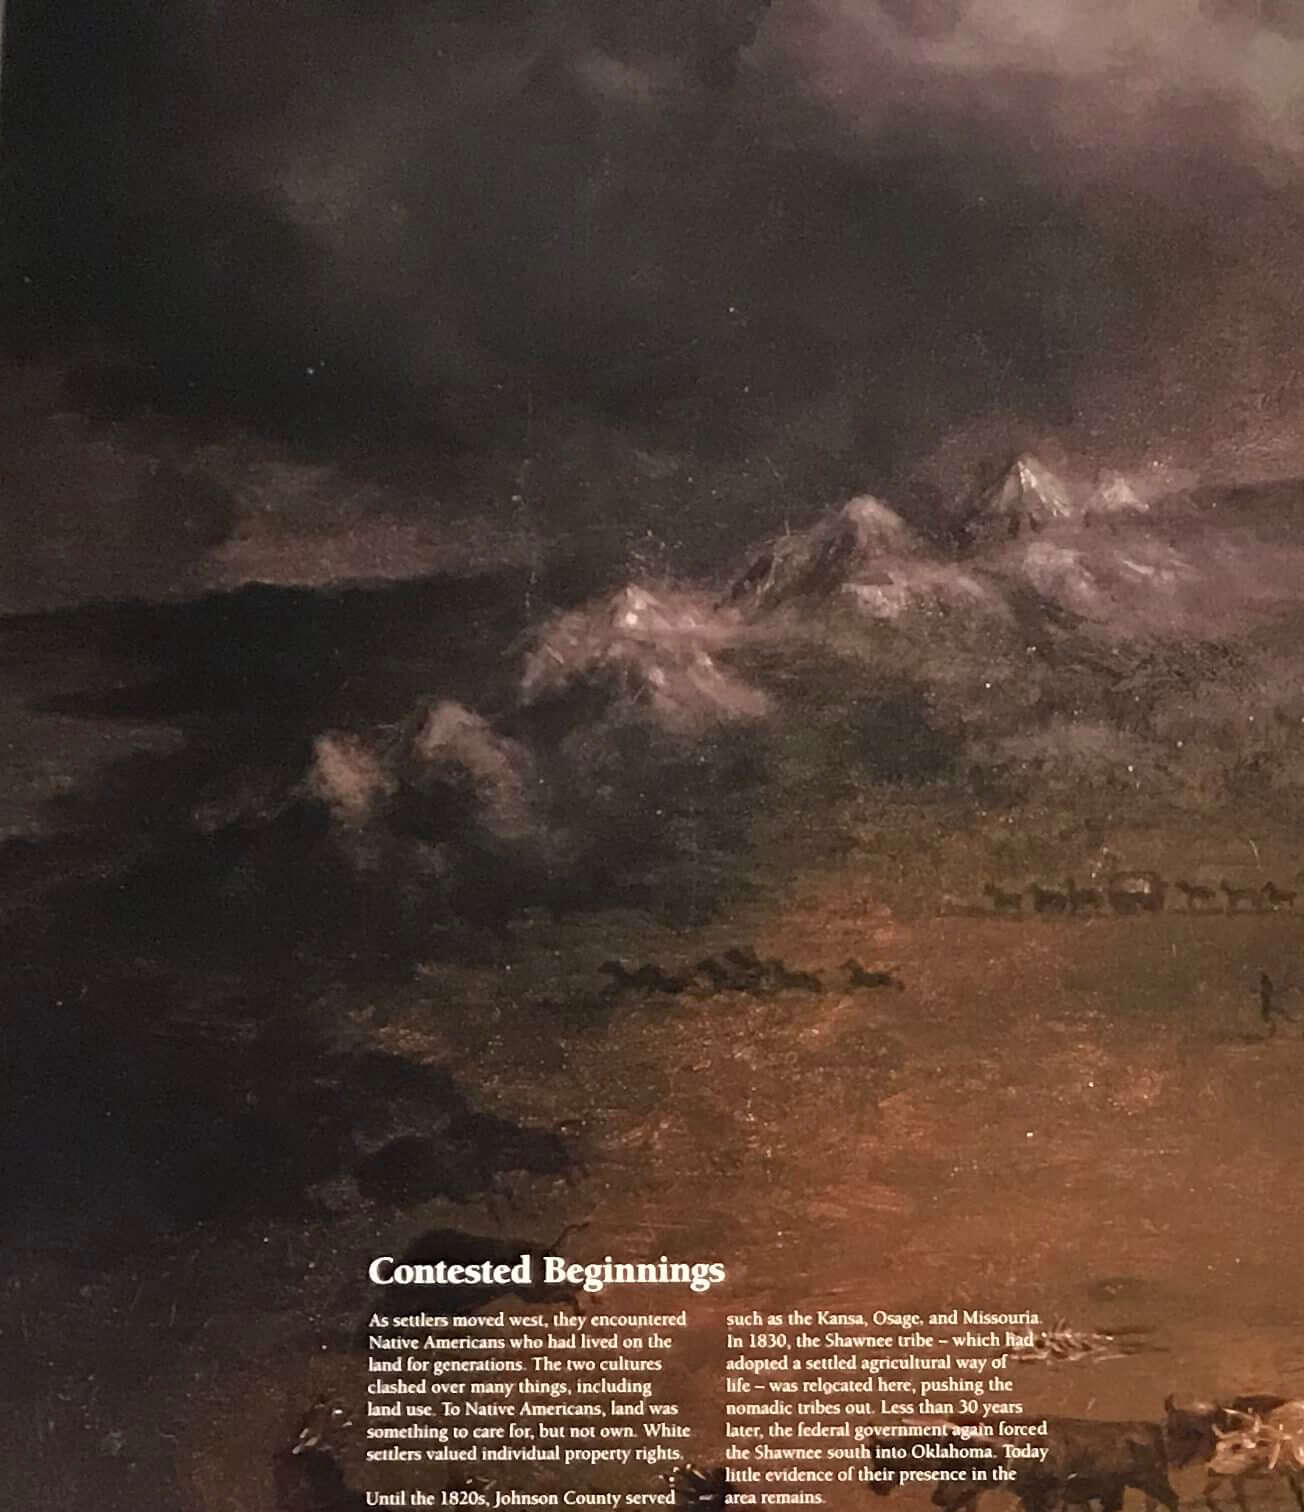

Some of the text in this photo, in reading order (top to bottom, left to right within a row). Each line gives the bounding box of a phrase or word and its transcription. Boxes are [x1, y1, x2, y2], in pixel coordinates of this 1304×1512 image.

[369, 1254, 726, 1292] Contested Beginnings
[369, 1310, 686, 1330] As settlers moved west, they encountered
[727, 1310, 1041, 1329] such as the Kansa, Osage, and Missouria.
[369, 1333, 672, 1350] Native Americans who had lived on the
[728, 1334, 744, 1348] In
[750, 1333, 791, 1350] 1830,
[796, 1332, 822, 1348] the
[824, 1332, 893, 1348] Shawnee
[898, 1332, 934, 1347] tribe
[952, 1331, 1000, 1347] which
[1005, 1331, 1036, 1347] had
[368, 1356, 662, 1376] land for generations. The two cultures
[726, 1353, 1009, 1374] adopted a settled agricultural way of
[368, 1378, 652, 1398] clashed over many things, including
[726, 1377, 750, 1392] life
[769, 1382, 798, 1392] was
[802, 1377, 873, 1393] relocated
[878, 1376, 916, 1394] here,
[920, 1376, 984, 1396] pushing
[989, 1376, 1013, 1391] the
[368, 1400, 678, 1417] land use. To Native Americans, land was
[726, 1399, 1023, 1418] nomadic tribes out. Less than 30 years
[366, 1422, 691, 1442] something to care for, but not own. White
[726, 1421, 1048, 1440] later, the federal government again forced
[366, 1445, 684, 1464] settlers valued individual property rights.
[726, 1443, 1049, 1461] the Shawnee south into Oklahoma. Today
[725, 1466, 1017, 1486] little evidence of their presence in the
[366, 1489, 676, 1508] Until the 1820s, Johnson County served
[724, 1490, 826, 1504] area remains.
